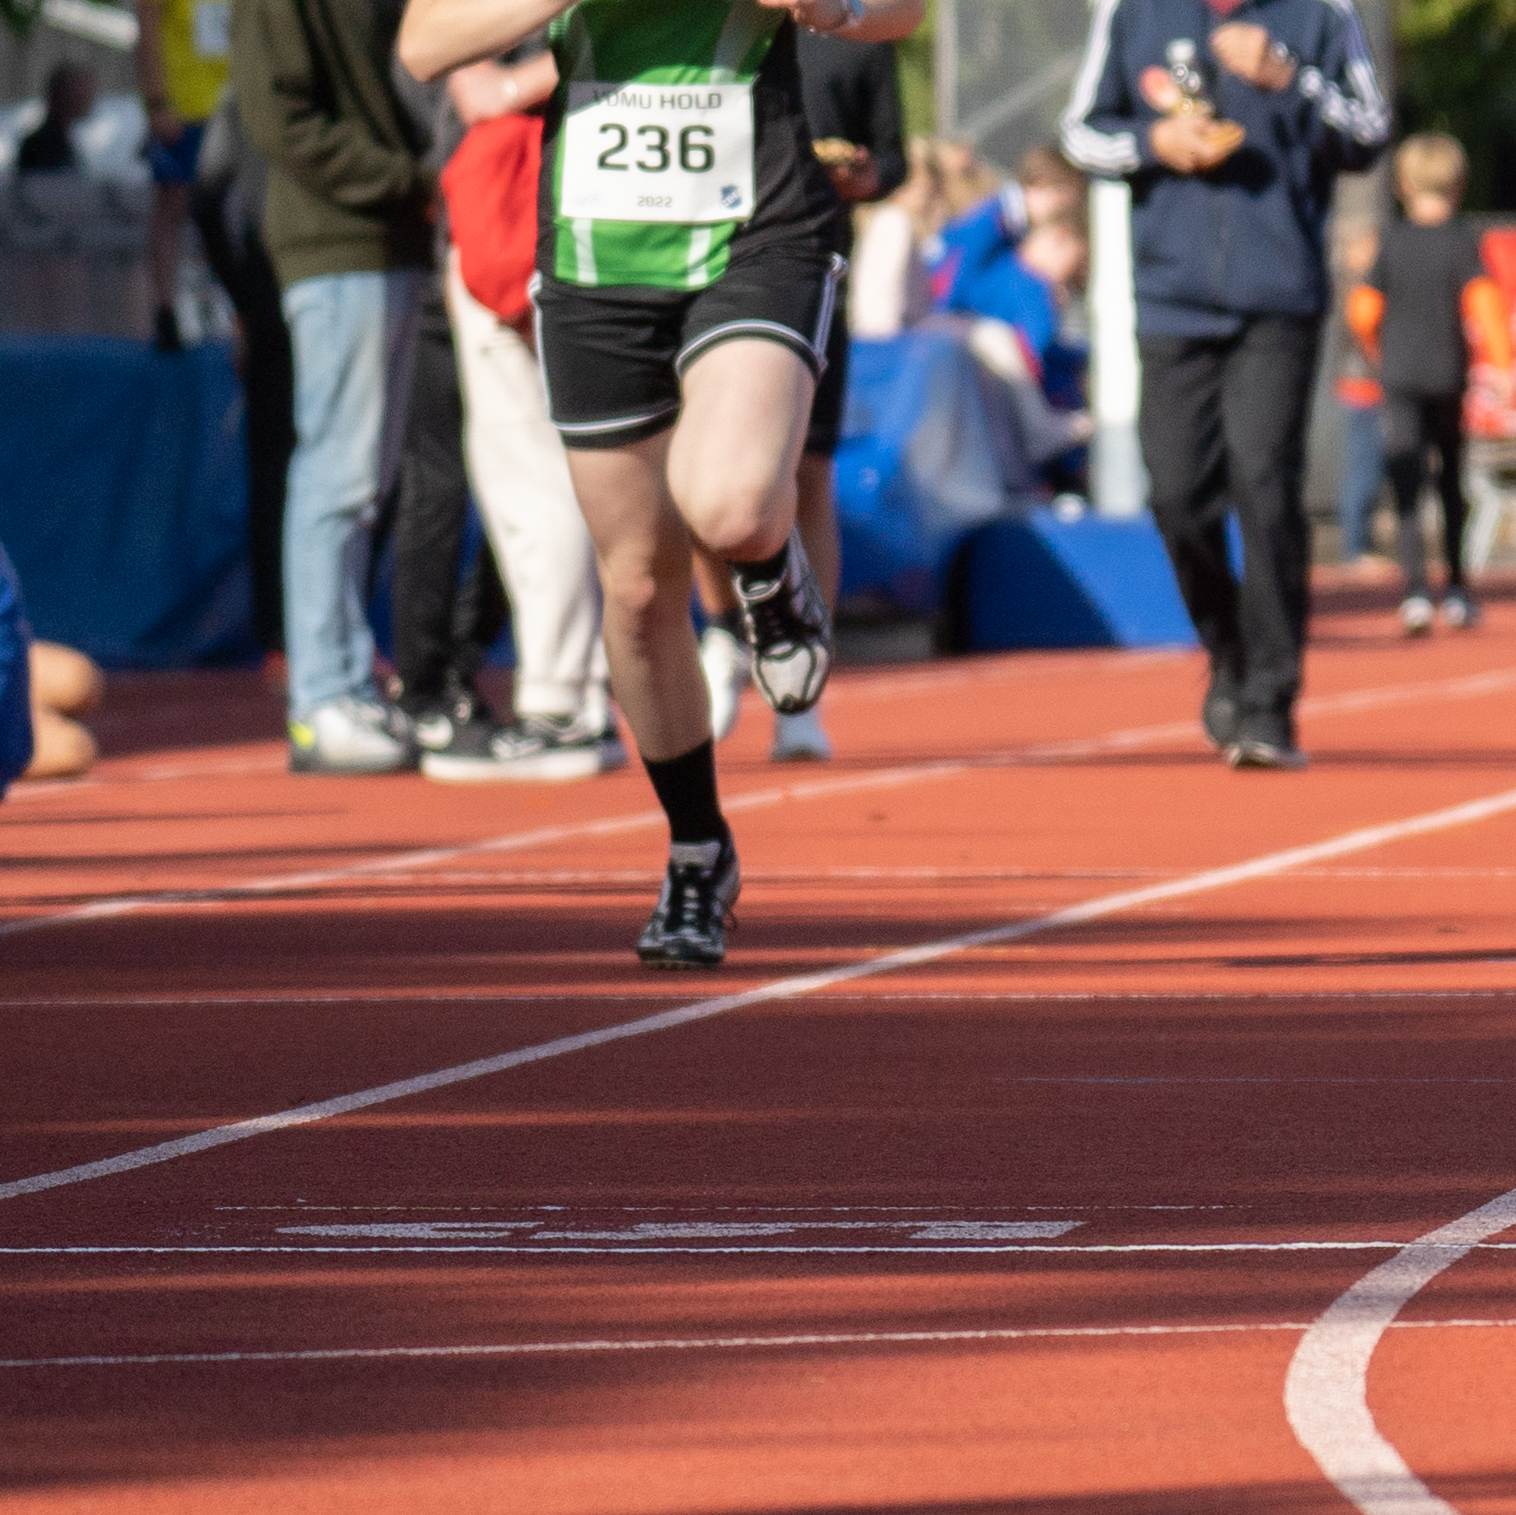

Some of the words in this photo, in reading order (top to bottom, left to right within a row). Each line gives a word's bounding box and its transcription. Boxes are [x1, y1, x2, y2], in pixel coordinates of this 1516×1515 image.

[659, 93, 722, 109] HOLD
[597, 123, 716, 174] 236
[636, 195, 673, 208] 2022
